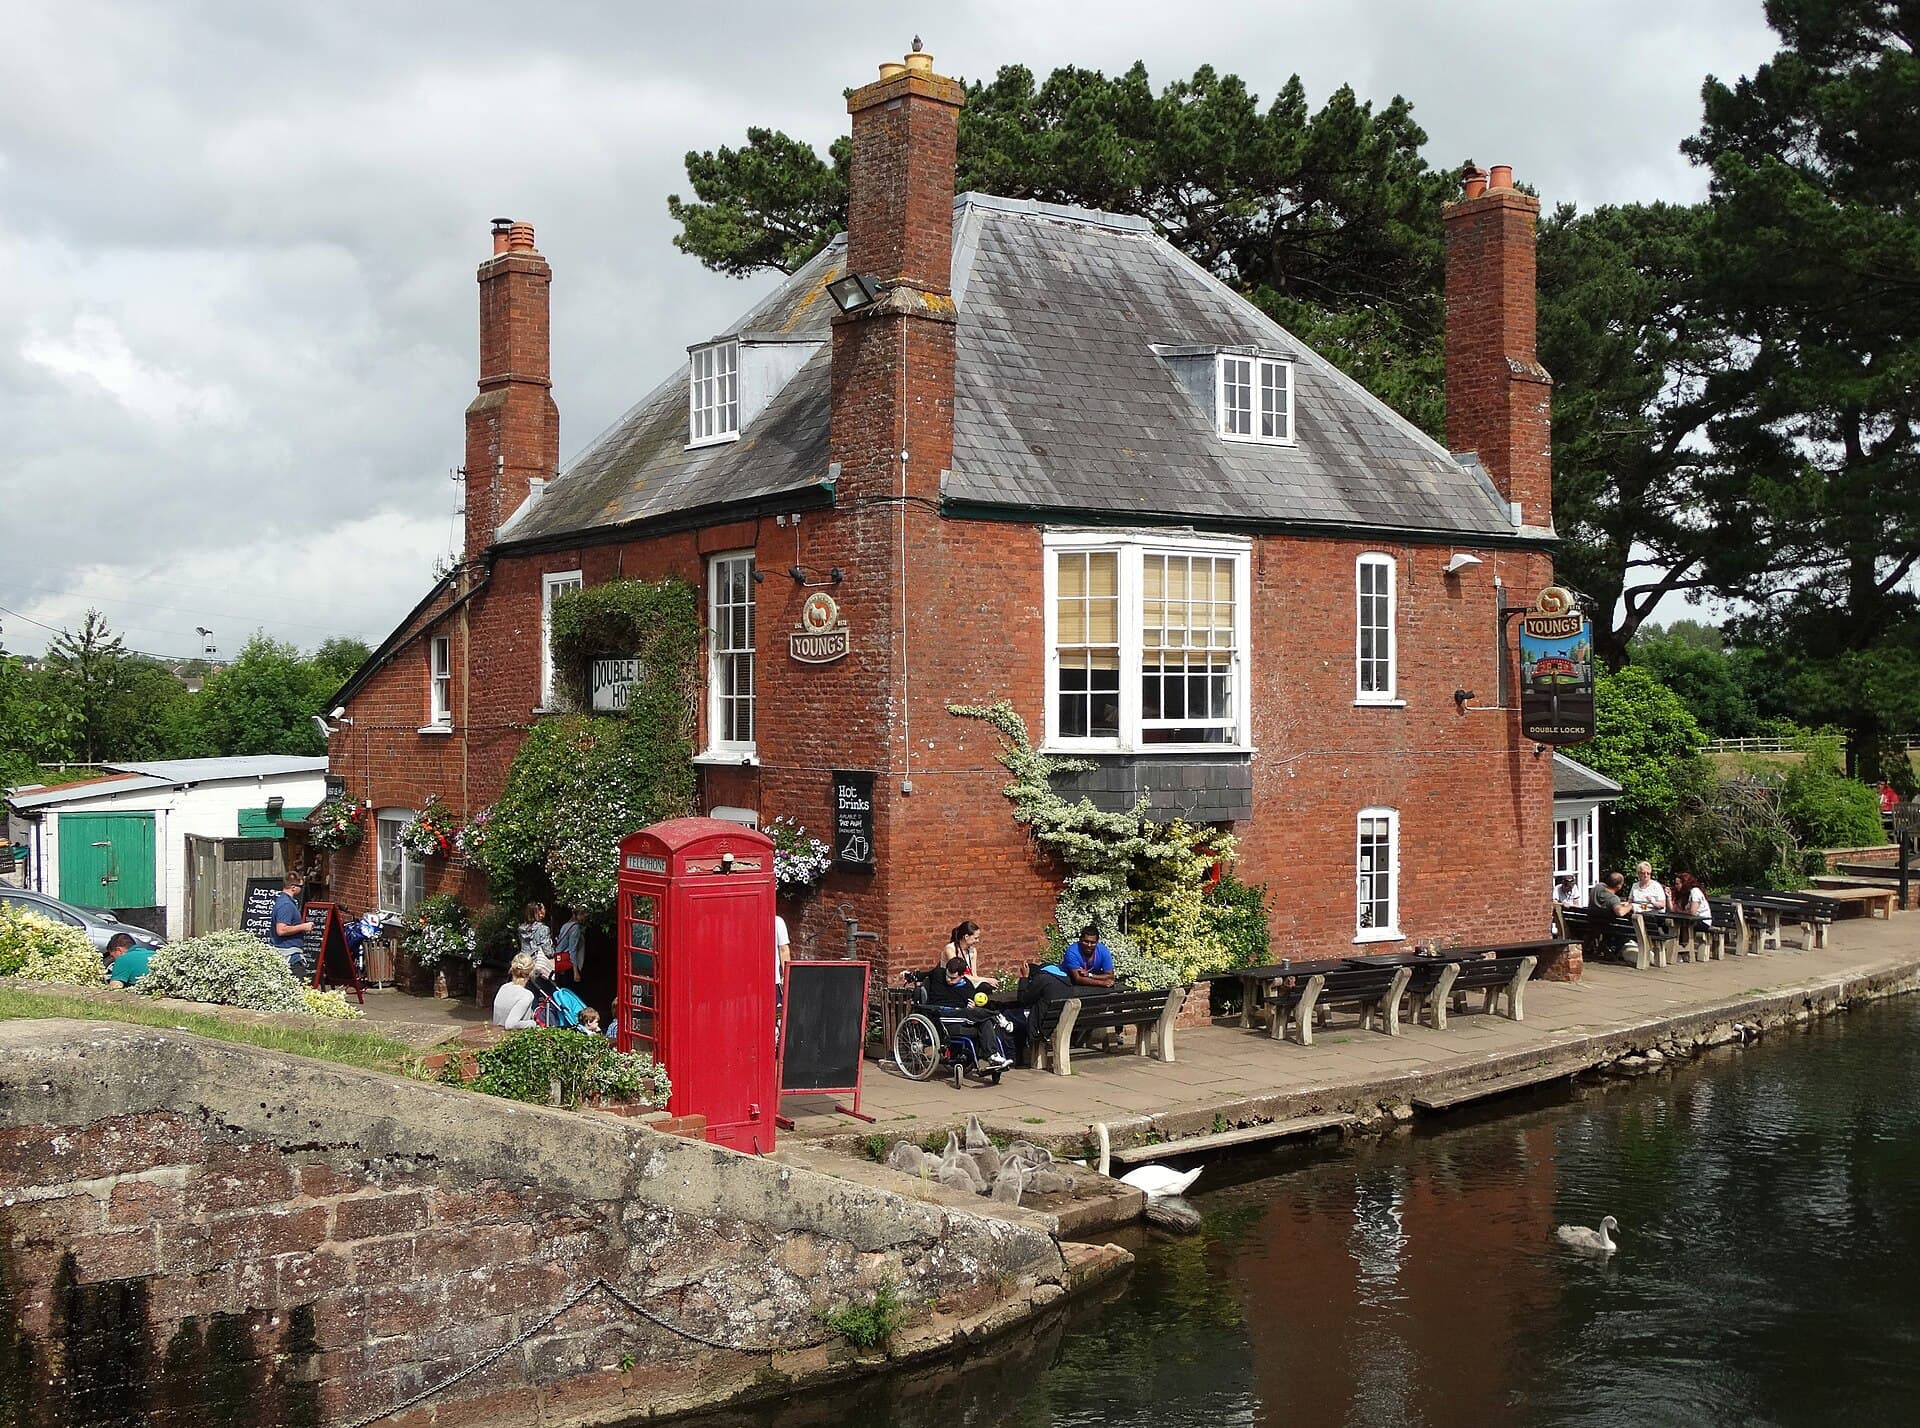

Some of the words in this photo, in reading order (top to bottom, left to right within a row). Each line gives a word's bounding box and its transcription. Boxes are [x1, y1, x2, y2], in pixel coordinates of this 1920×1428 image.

[1529, 618, 1578, 634] YOUNG'S
[795, 635, 844, 657] YOUNG'S
[594, 660, 634, 693] DOUBLE
[1529, 726, 1559, 734] DOUBLE
[838, 785, 858, 798] Hot
[838, 798, 870, 811] Drinks
[628, 855, 666, 872] TELEPHONE
[253, 888, 269, 900] DOG
